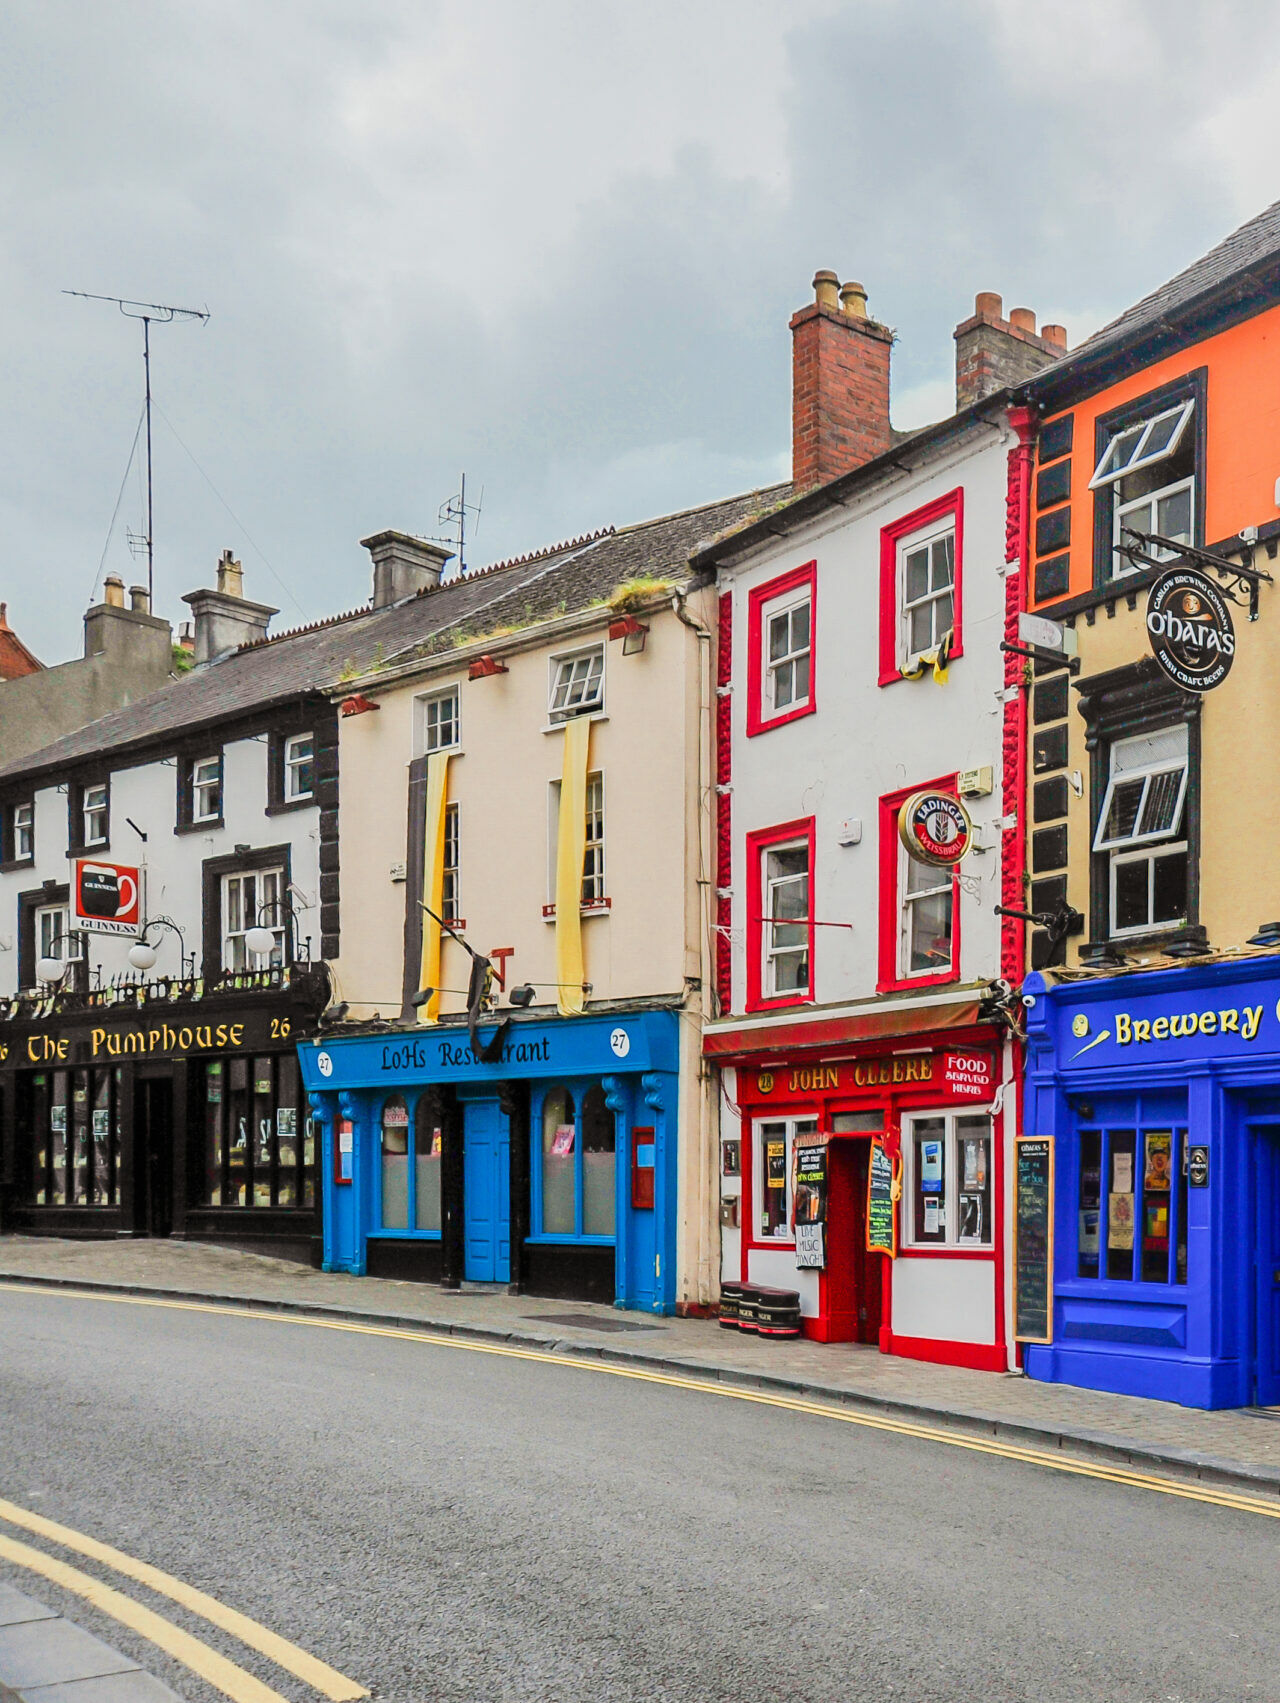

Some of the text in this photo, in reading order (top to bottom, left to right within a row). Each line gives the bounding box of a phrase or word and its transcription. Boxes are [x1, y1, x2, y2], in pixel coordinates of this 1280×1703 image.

[1153, 575, 1229, 631] CARLOW BREWING COMPANY
[1159, 649, 1225, 686] IRISH CRAFT BEERS
[917, 800, 965, 828] ERDINGER
[81, 919, 137, 933] GUINNESS
[270, 1017, 291, 1038] 26
[612, 1034, 626, 1049] 27
[438, 1036, 550, 1066] Resrant
[319, 1058, 331, 1070] 27
[948, 1056, 987, 1073] FOOD
[760, 1075, 772, 1089] 28
[789, 1058, 933, 1092] JOHN CLEERE
[945, 1071, 989, 1084] SERVED
[952, 1083, 982, 1095] HERE
[799, 1240, 818, 1251] MUSIC
